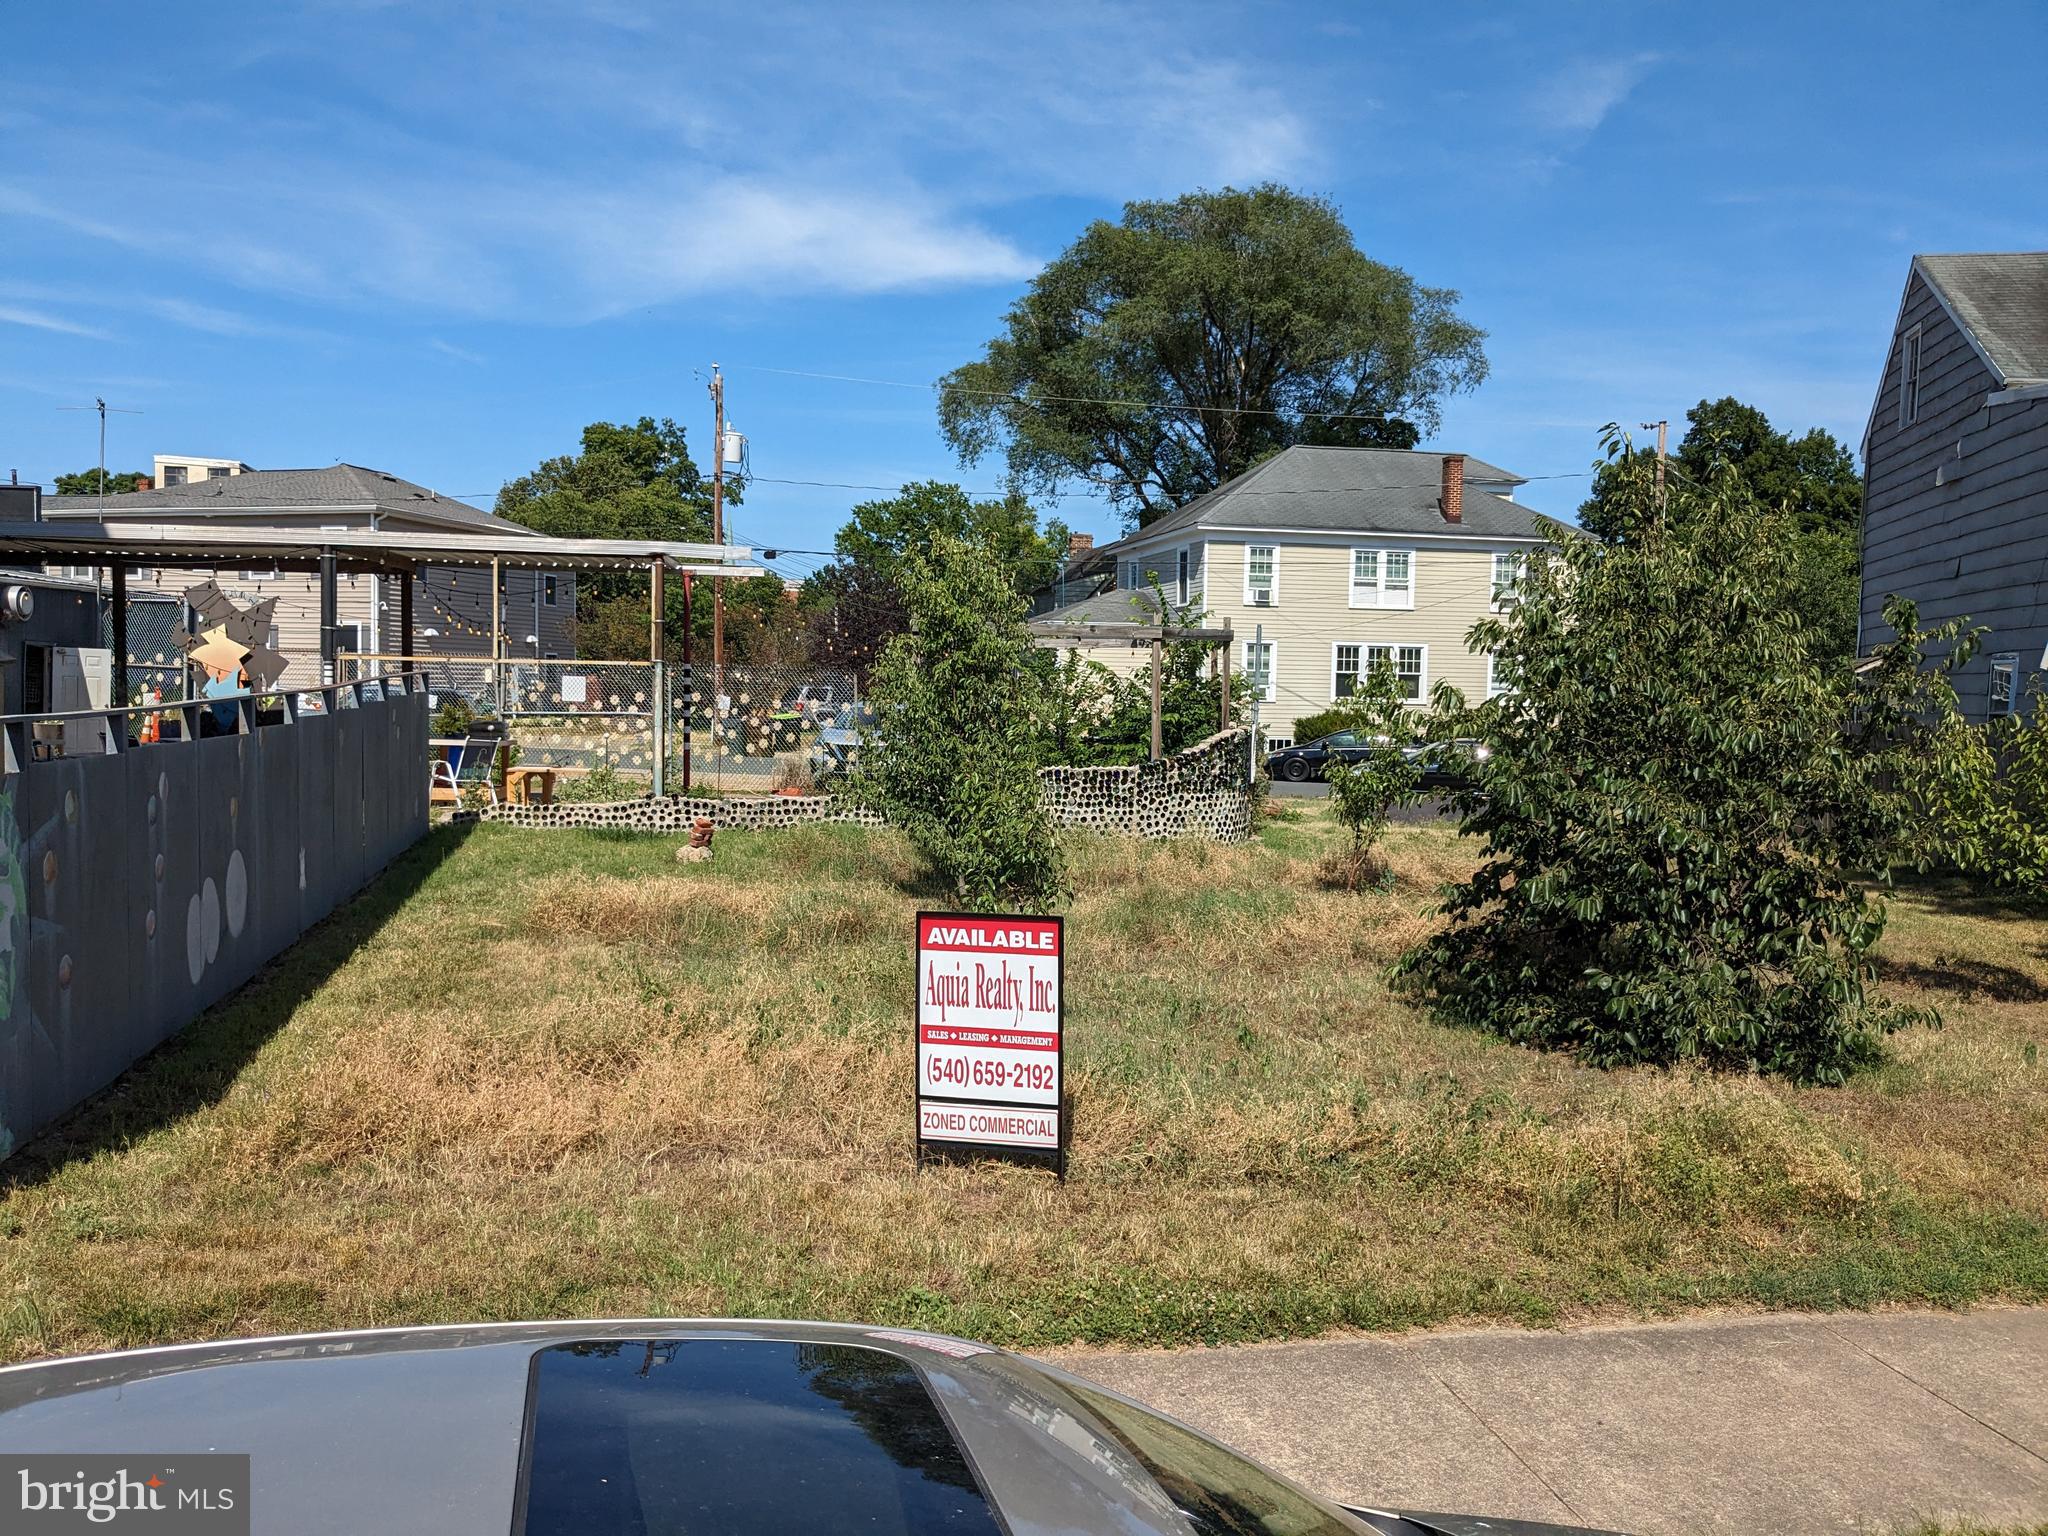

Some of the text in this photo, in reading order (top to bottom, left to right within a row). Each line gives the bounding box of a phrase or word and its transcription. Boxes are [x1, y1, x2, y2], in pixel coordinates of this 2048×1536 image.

[927, 927, 1054, 950] AVAILABLE
[925, 959, 1056, 1028] Aquia Realty, Inc.
[927, 1030, 1053, 1047] SALES LEASING MANAGEMENT
[927, 1053, 1054, 1090] (540) 659-2192
[923, 1112, 1055, 1137] ZONED COMMERCIAL
